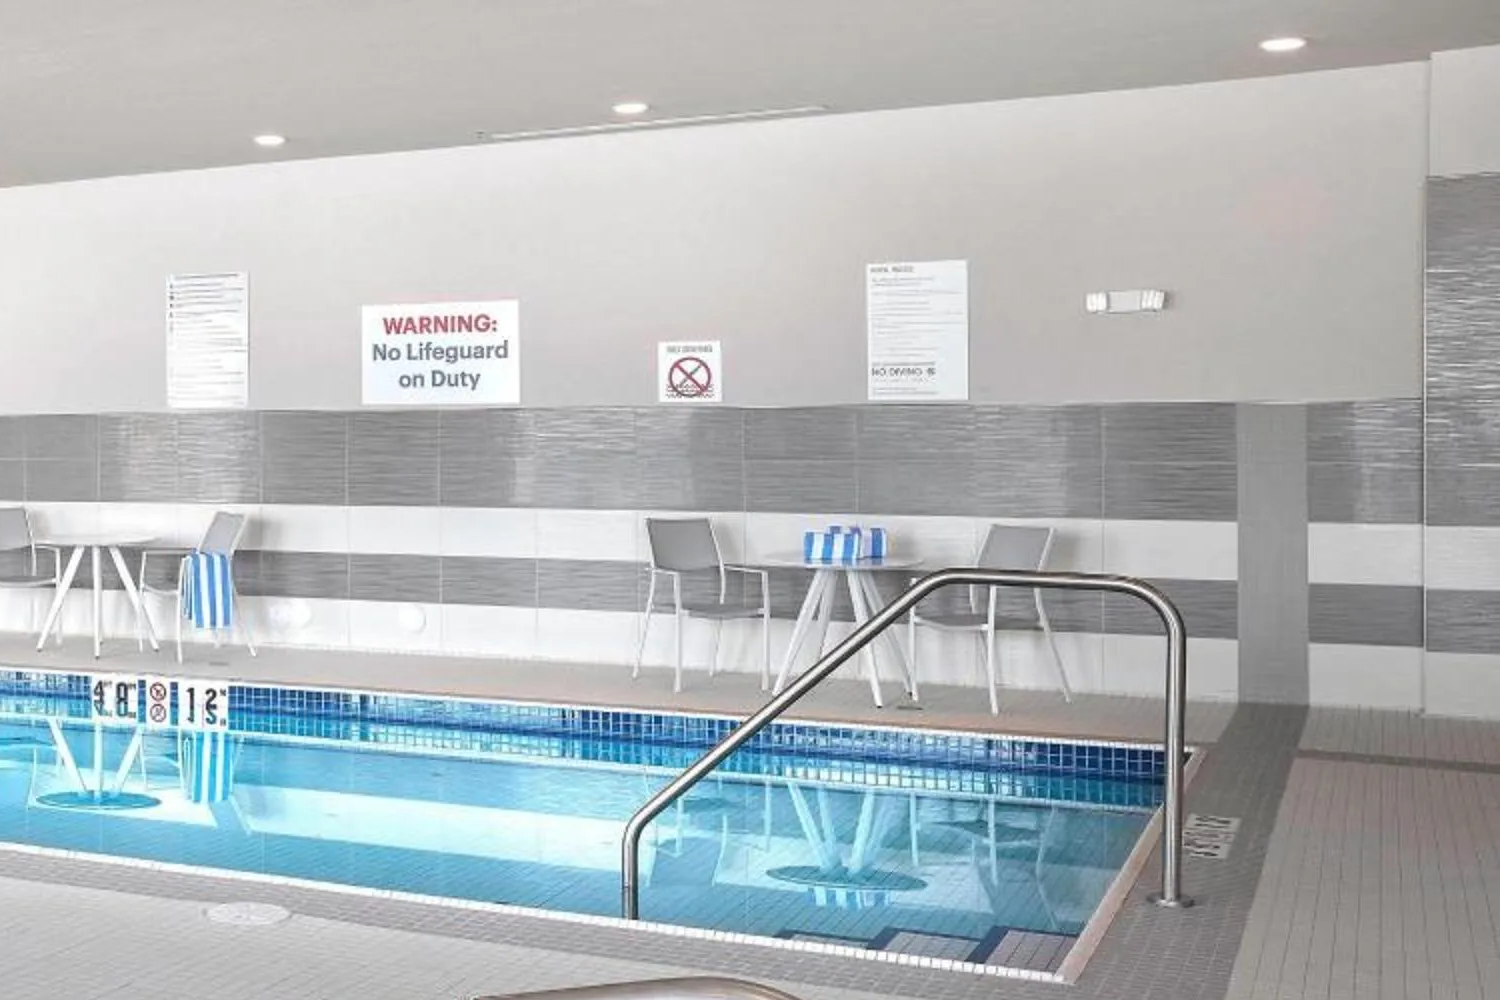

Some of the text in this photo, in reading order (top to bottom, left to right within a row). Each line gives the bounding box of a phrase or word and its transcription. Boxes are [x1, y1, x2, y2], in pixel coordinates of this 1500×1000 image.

[382, 313, 498, 335] WARNING:
[372, 340, 509, 364] No Lifeguard
[398, 369, 481, 391] on Duty
